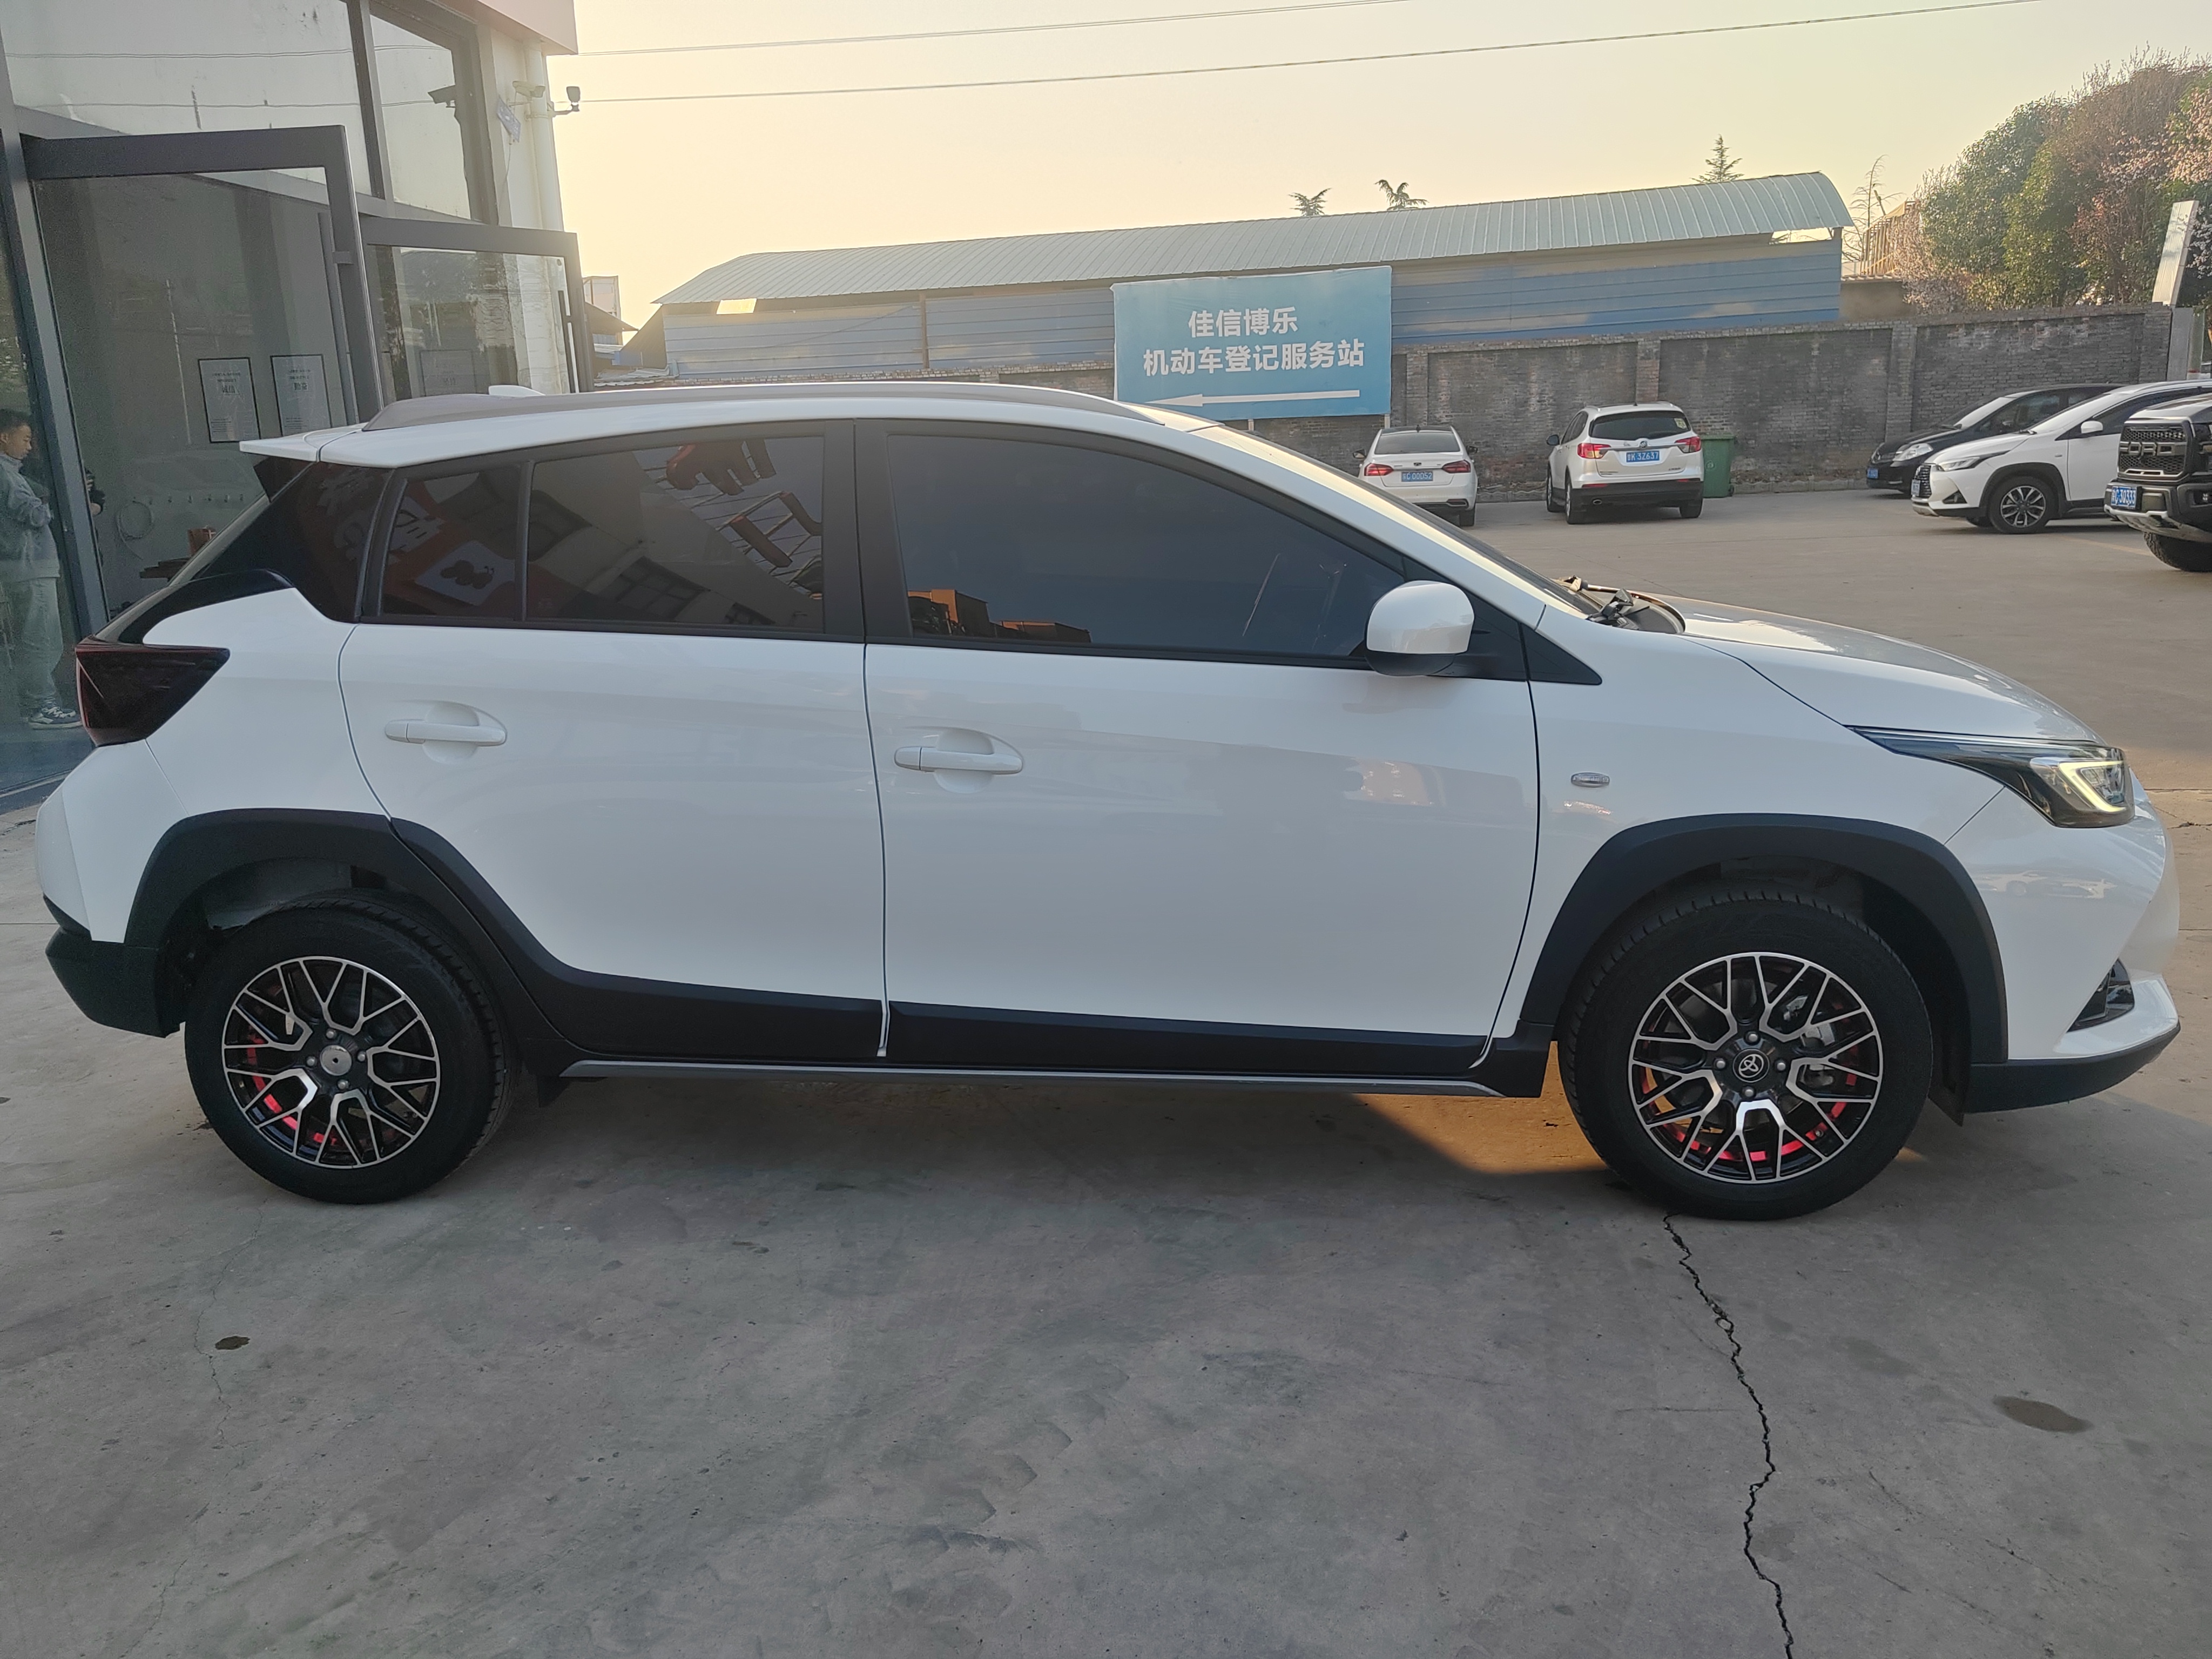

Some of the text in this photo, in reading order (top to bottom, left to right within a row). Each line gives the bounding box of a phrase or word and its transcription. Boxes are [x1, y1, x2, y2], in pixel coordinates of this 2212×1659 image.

[1188, 307, 1298, 338] 佳信博乐
[1143, 339, 1364, 376] 机动车登记服务站
